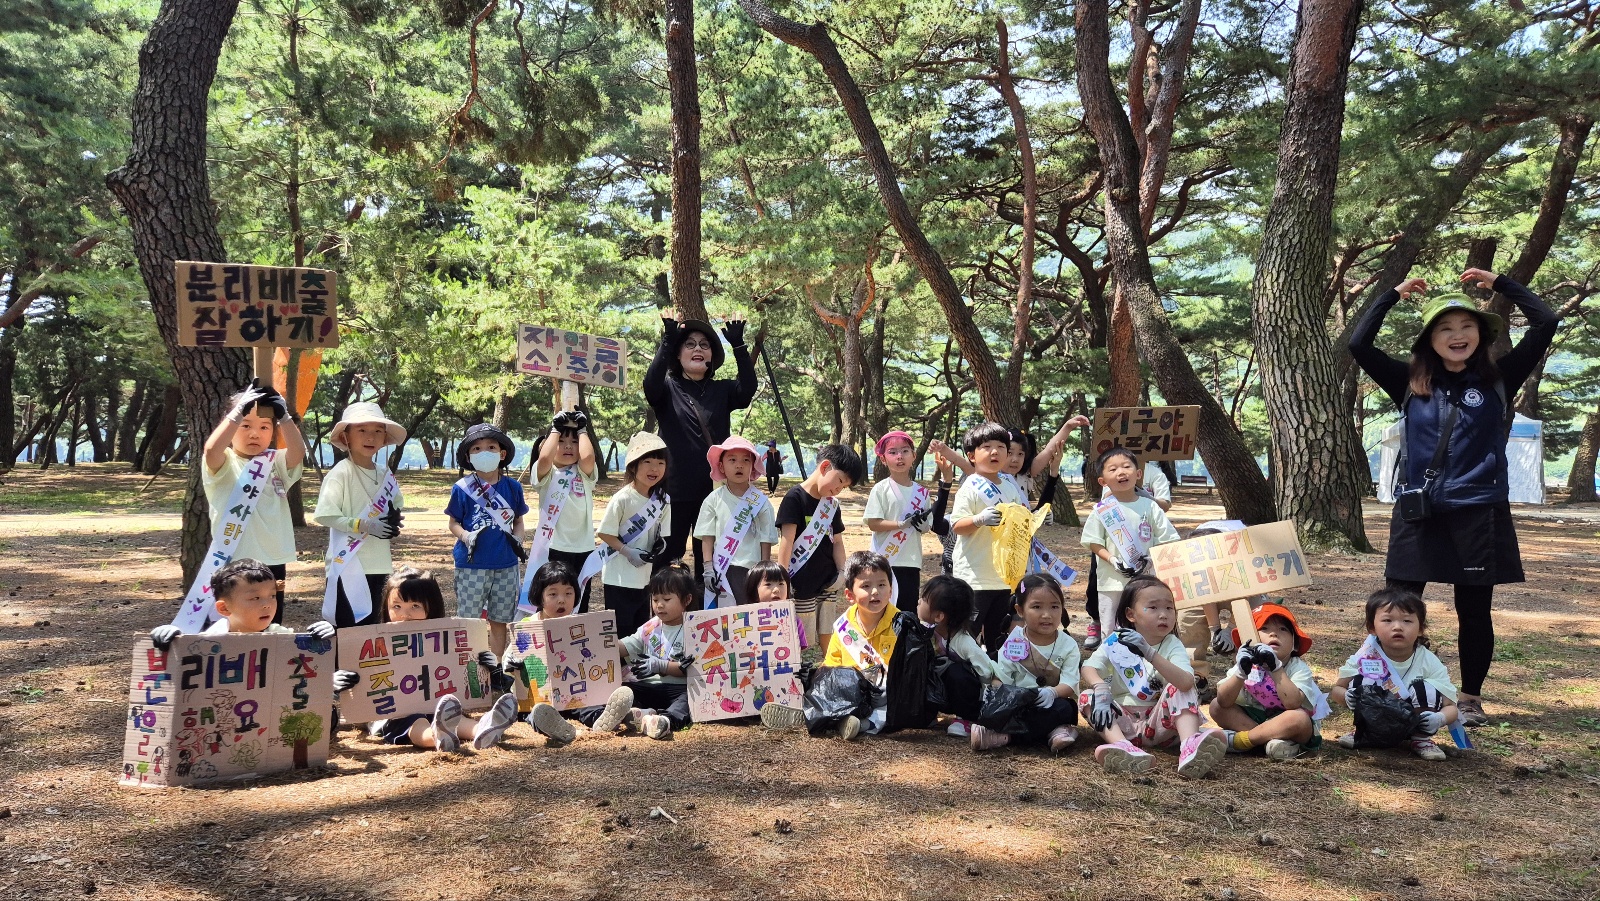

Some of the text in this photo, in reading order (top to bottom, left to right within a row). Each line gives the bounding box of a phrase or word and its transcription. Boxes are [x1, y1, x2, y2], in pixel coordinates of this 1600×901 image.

[185, 265, 328, 316] 분리배출
[192, 304, 333, 346] 잘하기!
[523, 327, 620, 365] 자연을
[1097, 408, 1184, 435] 지구야
[1157, 529, 1254, 571] 쓰레기
[1252, 549, 1304, 584] 않기
[359, 630, 473, 669] 쓰레기를
[702, 647, 793, 688] 지켜요
[367, 665, 457, 715] 줄여요
